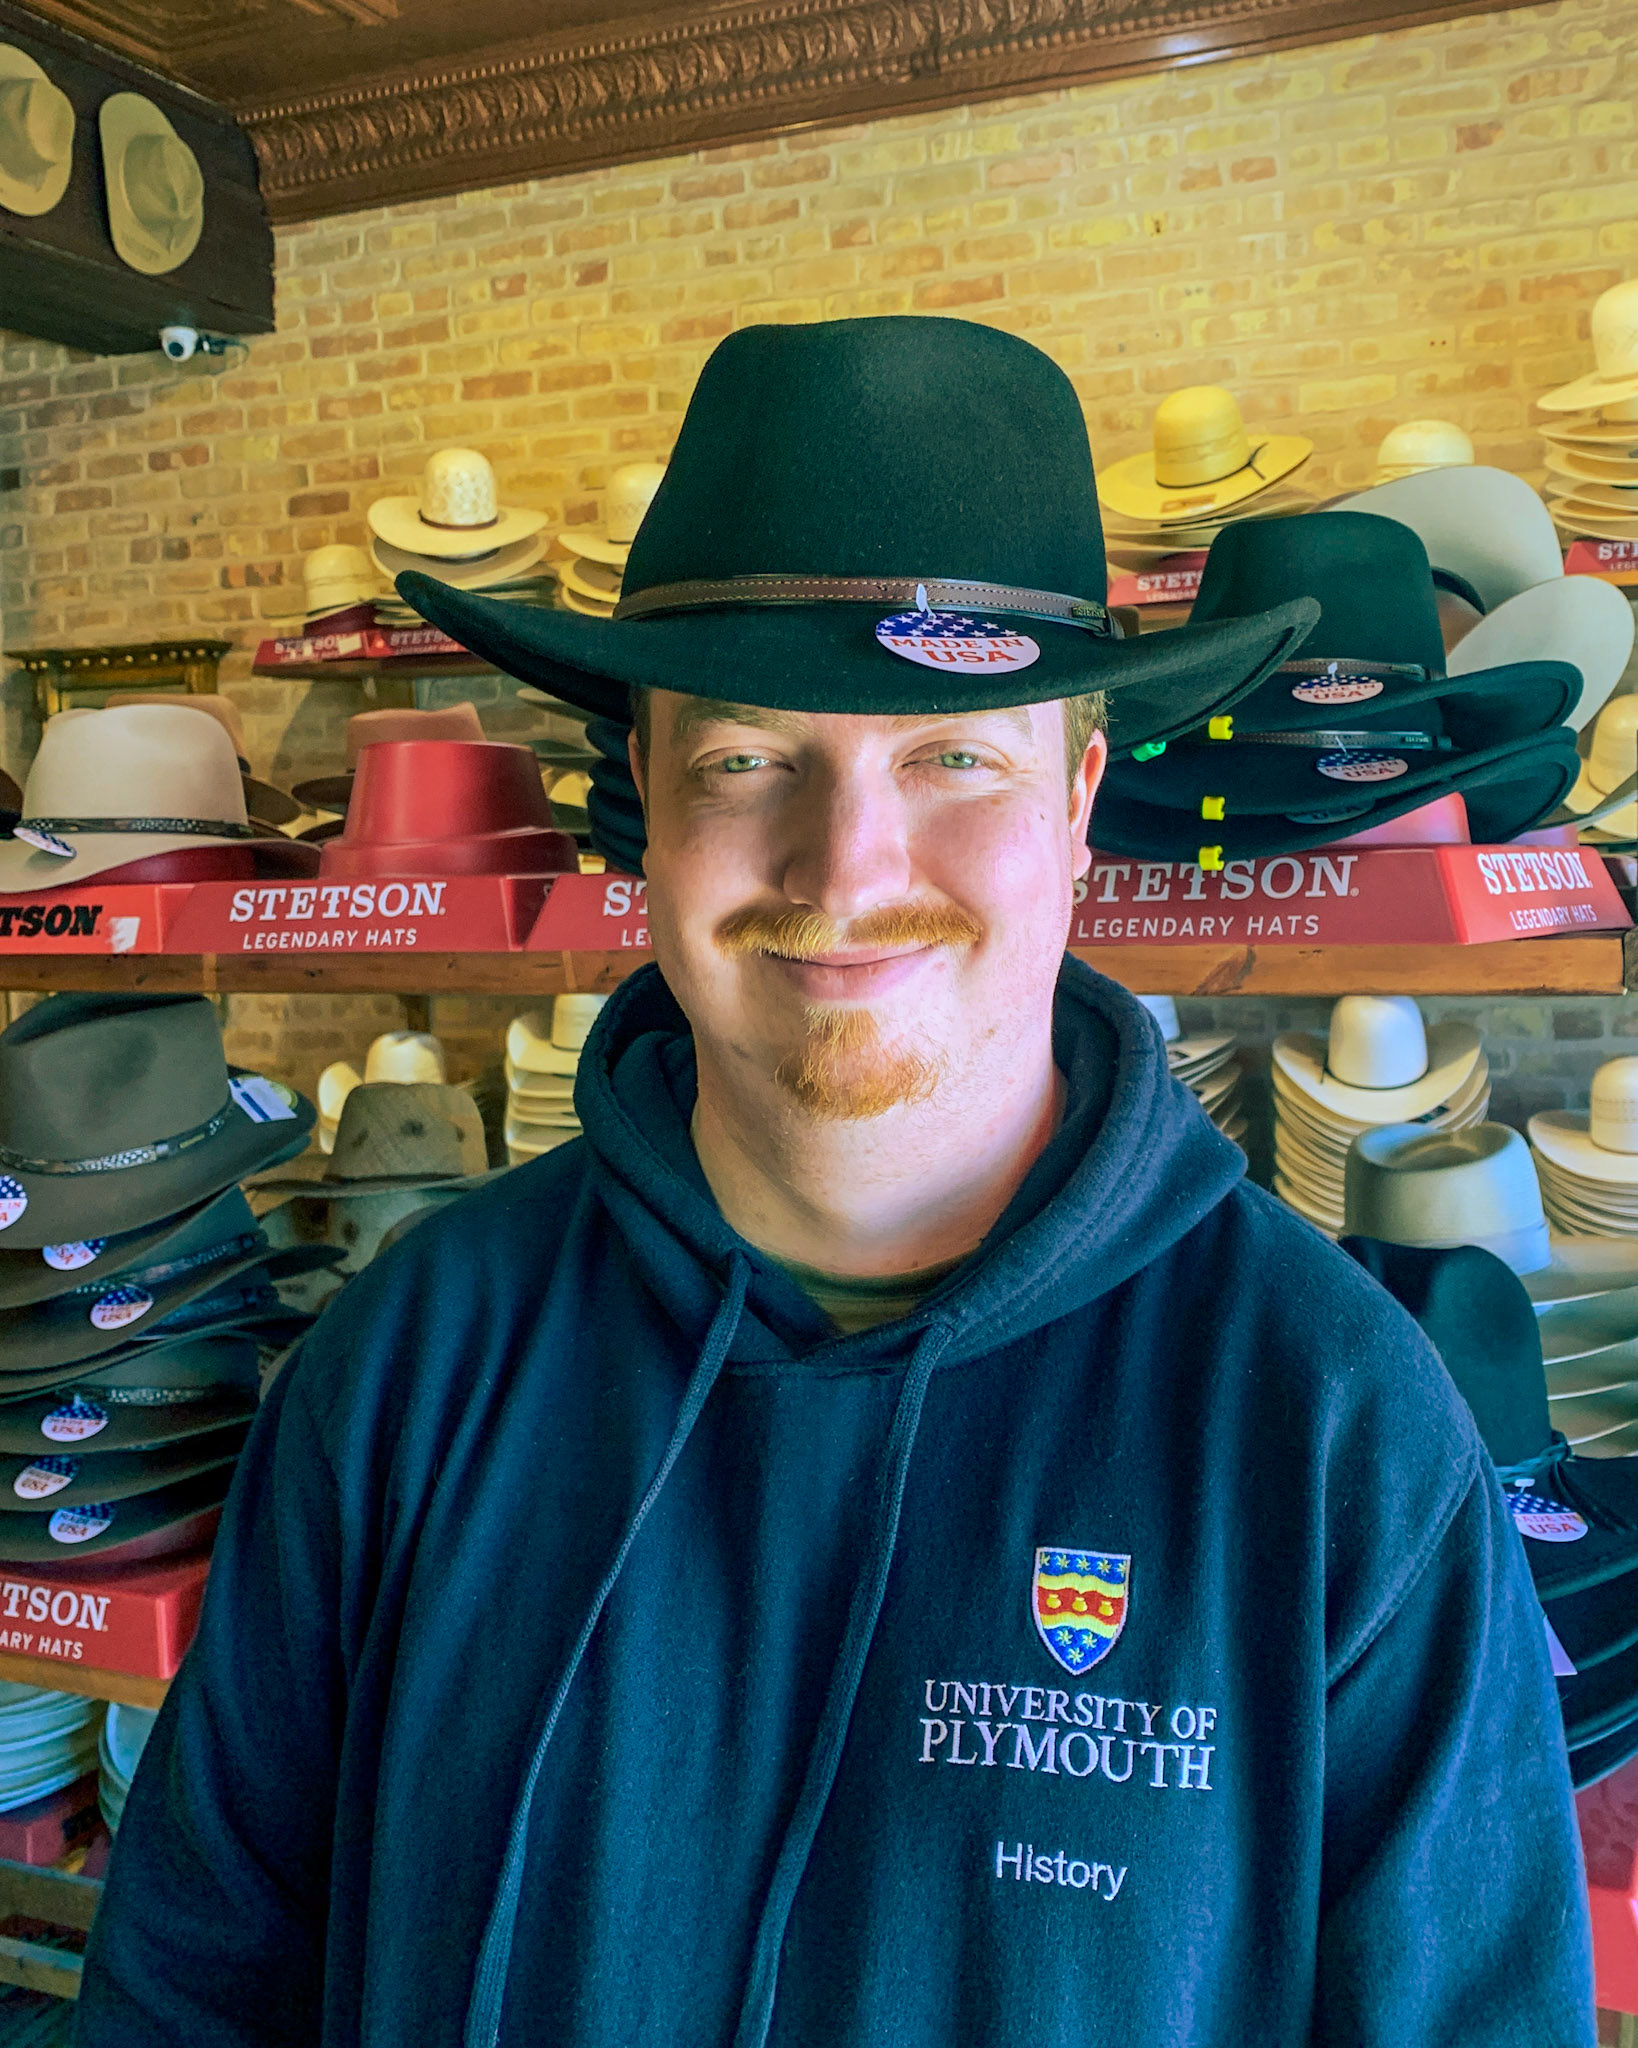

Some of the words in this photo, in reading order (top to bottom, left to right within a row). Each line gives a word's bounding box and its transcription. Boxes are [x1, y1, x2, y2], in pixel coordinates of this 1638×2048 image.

[889, 637, 982, 649] MADE
[989, 638, 1025, 648] IN
[922, 650, 1019, 664] USA
[1313, 691, 1365, 700] USA
[1344, 768, 1397, 778] USA
[1477, 852, 1592, 895] STETSON
[229, 881, 448, 923] STETSON
[1077, 916, 1234, 939] LEGENDARY
[1247, 914, 1320, 937] HATS
[1510, 906, 1572, 931] LEGENDARY
[1572, 904, 1598, 923] HATS
[242, 929, 359, 950] LEGENDARY
[365, 927, 418, 947] HATS
[621, 928, 652, 947] LE
[1528, 1522, 1579, 1534] USA
[38, 1635, 83, 1660] HATS
[925, 1679, 1163, 1736] UNIVERSITY
[1171, 1705, 1218, 1740] OF
[918, 1718, 1216, 1791] PLYMOUTH
[996, 1841, 1128, 1901] History
